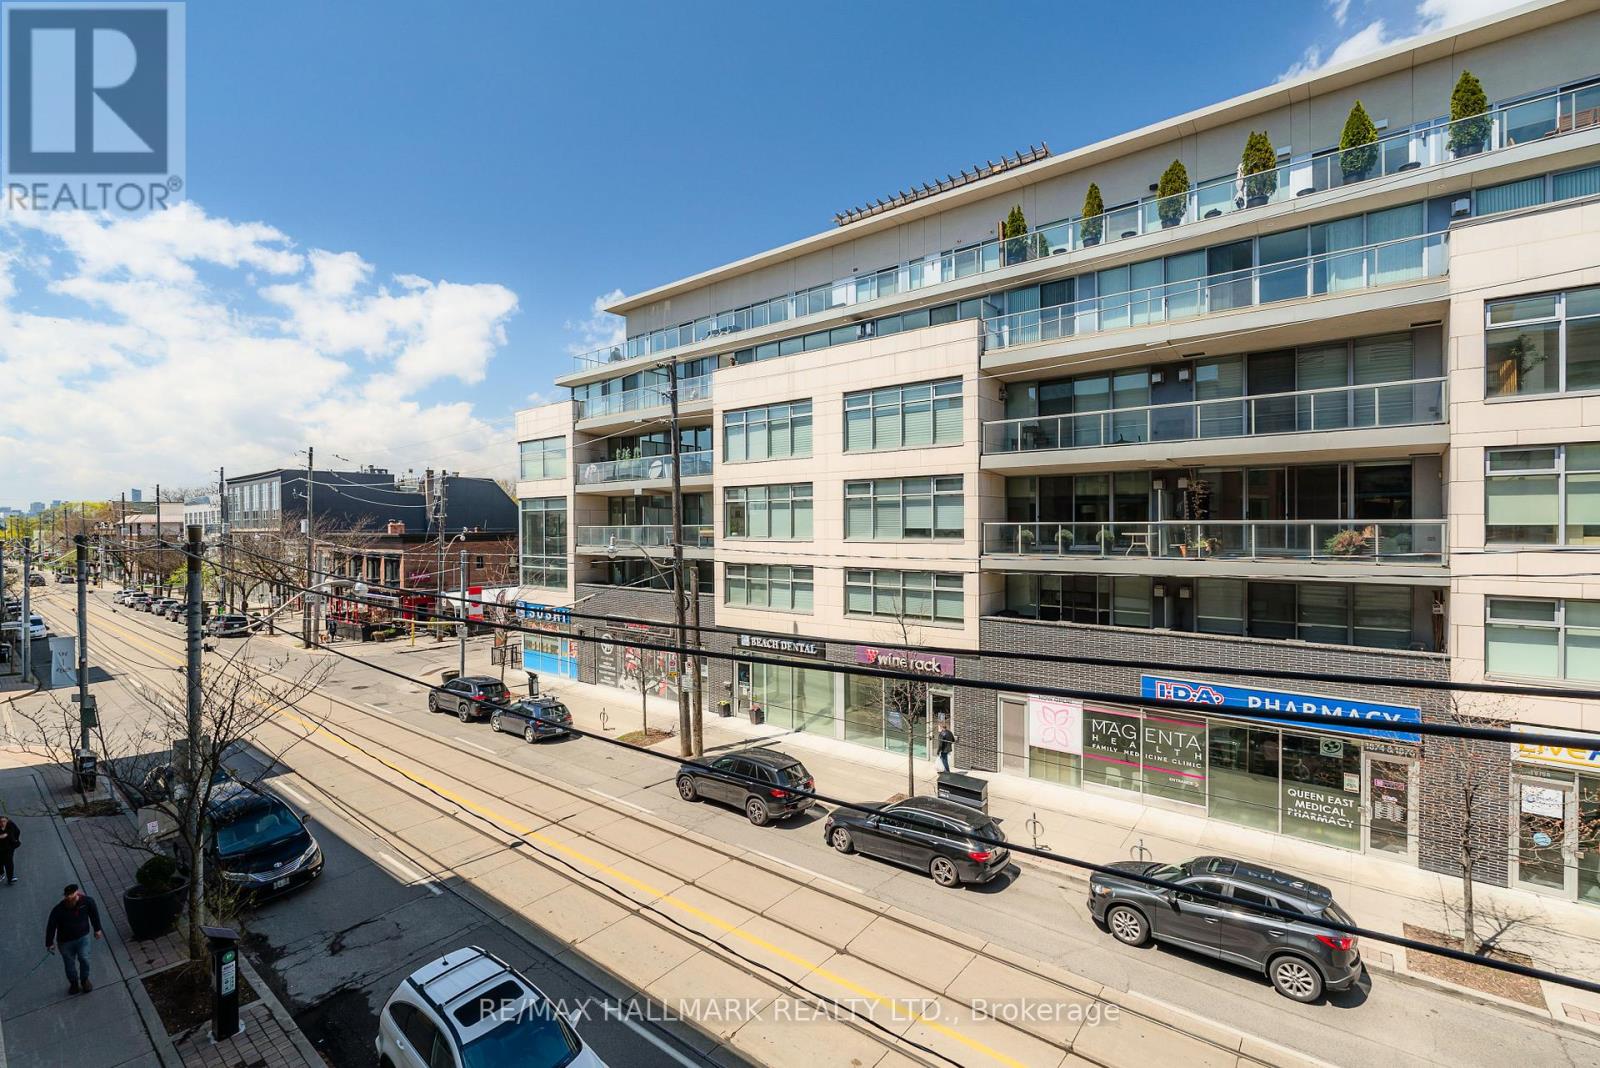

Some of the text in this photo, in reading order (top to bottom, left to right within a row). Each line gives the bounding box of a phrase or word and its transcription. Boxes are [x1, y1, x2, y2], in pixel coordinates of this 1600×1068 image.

[751, 637, 818, 655] BEACH DENTAL
[877, 652, 942, 673] wine rack
[1092, 719, 1202, 752] MAGENTA
[1091, 734, 1203, 761] HEALTH
[1091, 743, 1203, 769] FAMILY MEDICINE CLINIC
[1287, 788, 1356, 808] QUEEN EAST
[1294, 800, 1347, 817] MEDICAL
[1287, 807, 1356, 829] PHARMACY
